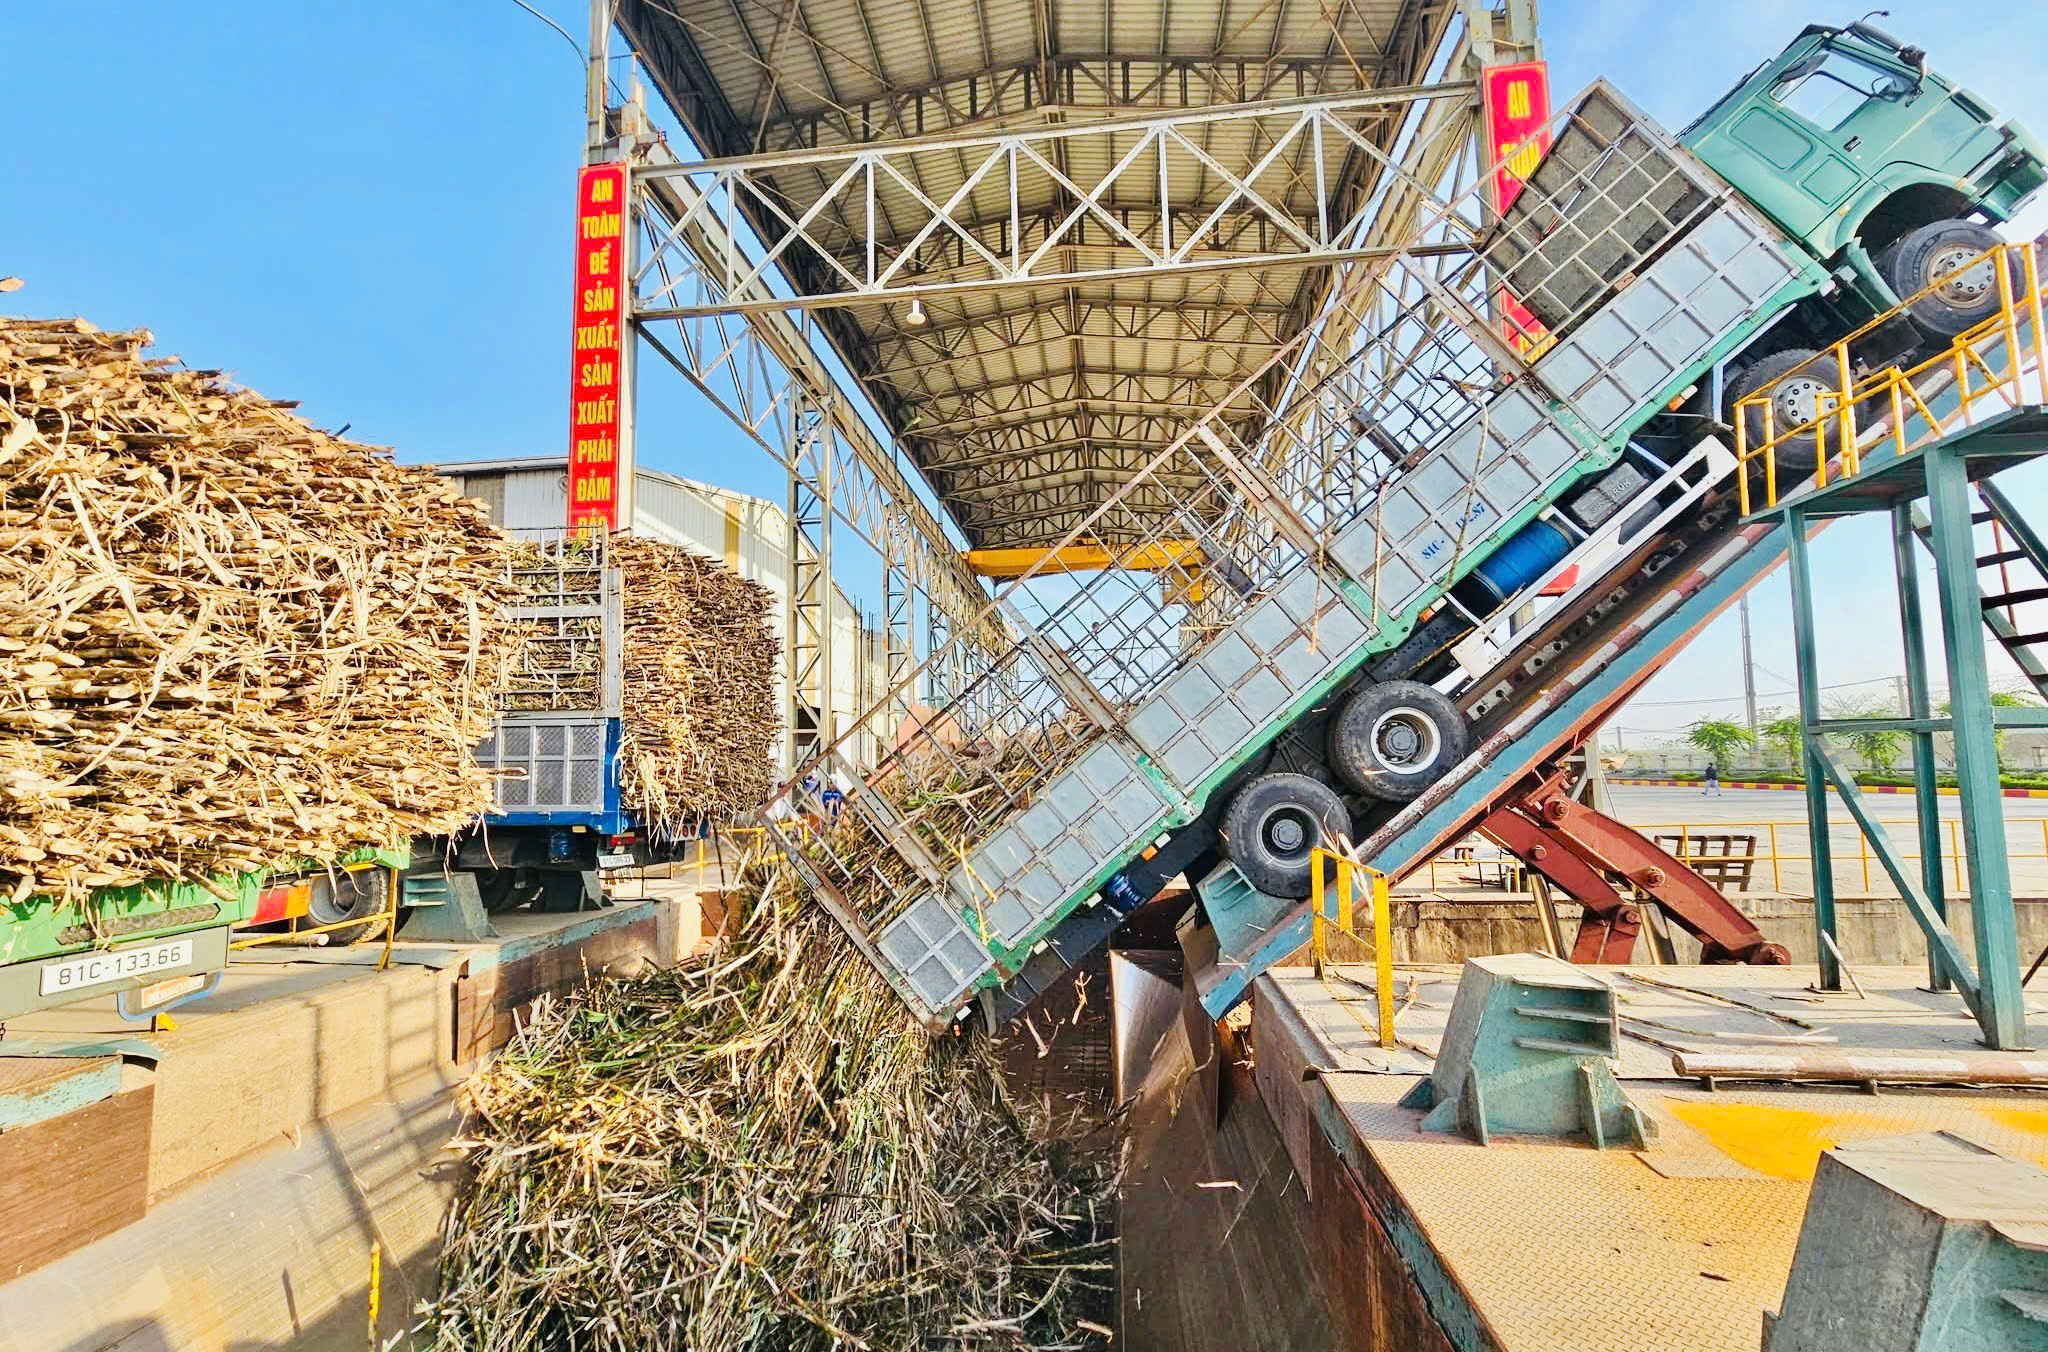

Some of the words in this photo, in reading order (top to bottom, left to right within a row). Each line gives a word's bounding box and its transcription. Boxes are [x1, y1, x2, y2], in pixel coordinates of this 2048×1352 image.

[1509, 81, 1530, 117] AN
[592, 179, 614, 202] AN
[582, 211, 620, 239] TOÀN
[584, 280, 614, 312] SẢN
[577, 318, 618, 350] XUẤT,
[582, 354, 613, 387] SẢN
[577, 393, 615, 425] XUẤT
[578, 430, 612, 463] PHẢI
[577, 469, 611, 502] ĐẢM
[59, 946, 181, 985] 81C-133.66
